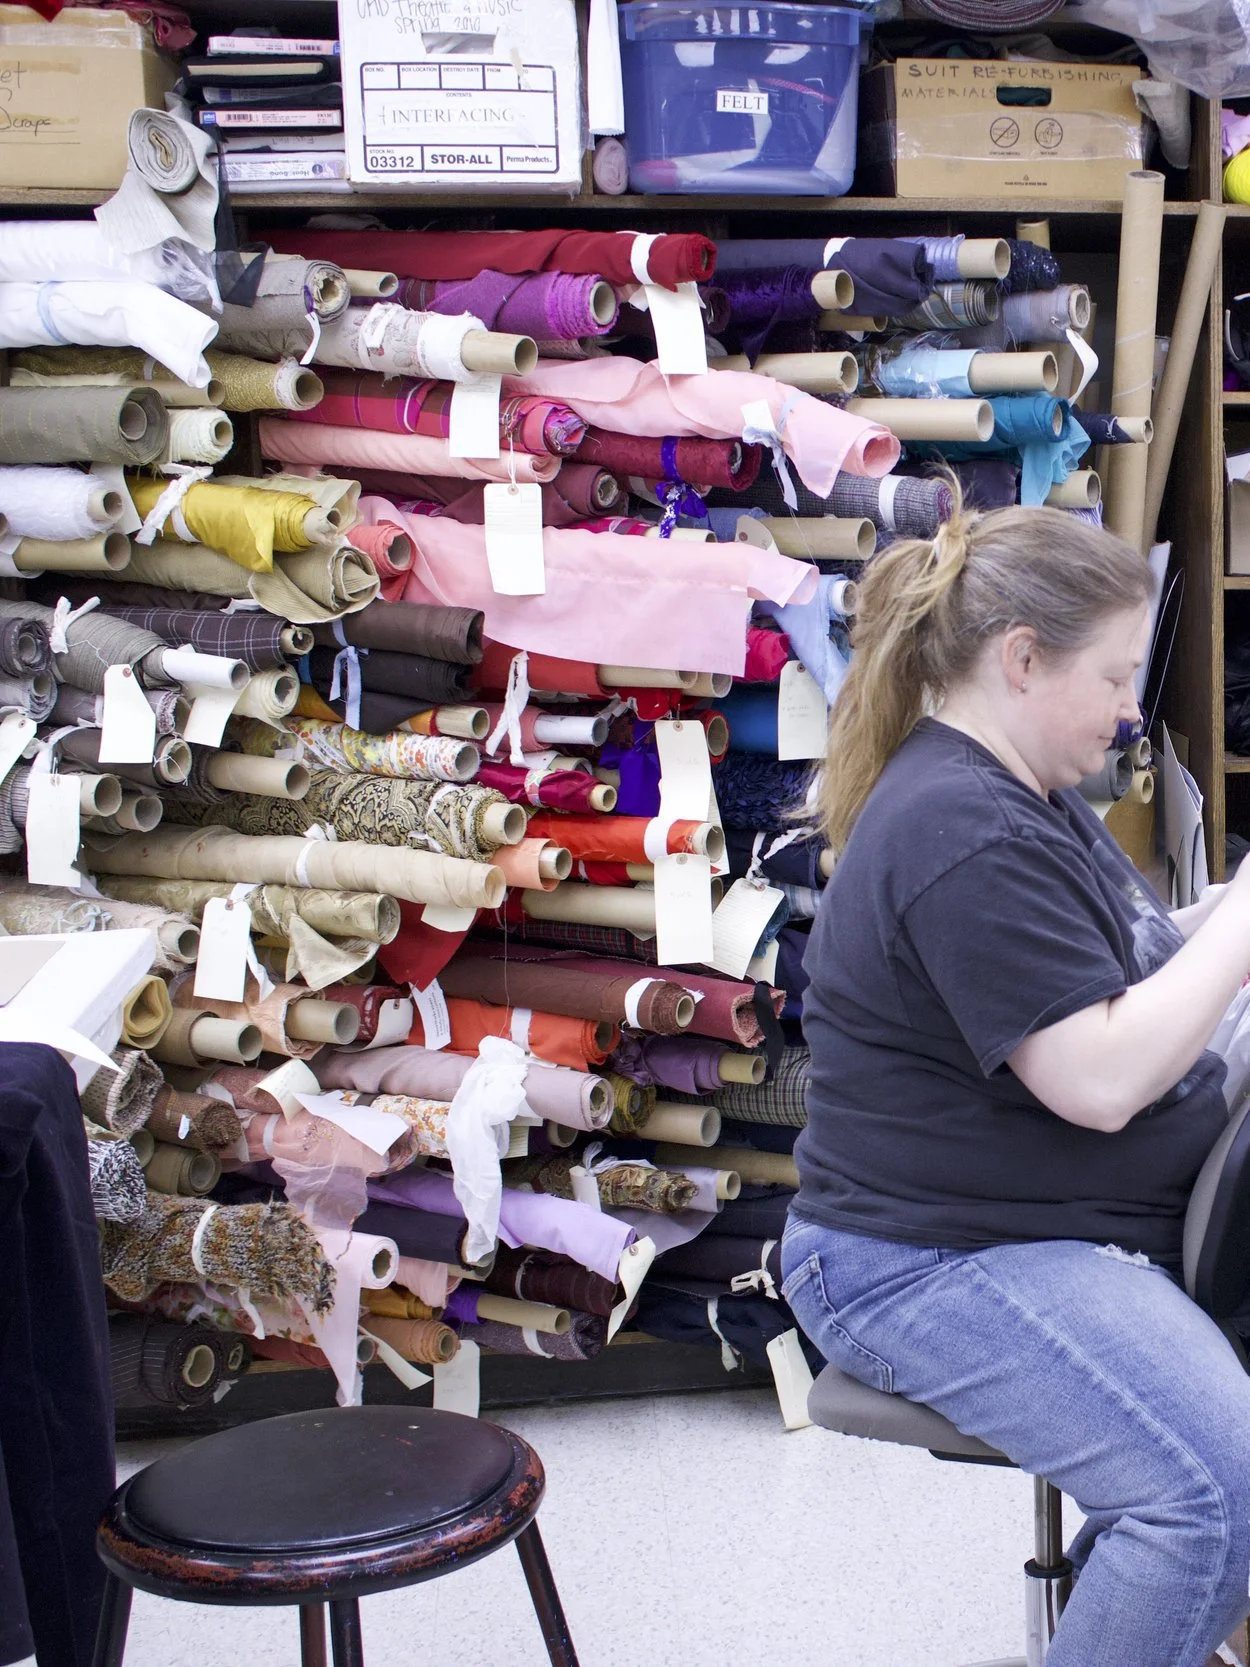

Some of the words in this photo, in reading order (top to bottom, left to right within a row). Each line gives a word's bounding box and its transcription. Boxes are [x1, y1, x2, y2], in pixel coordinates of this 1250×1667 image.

[908, 64, 960, 79] SUIT
[722, 94, 764, 110] FELT
[391, 108, 515, 124] INTERFACING
[370, 156, 415, 168] 03312
[431, 154, 493, 164] STOR-ALL
[506, 155, 525, 163] Perma
